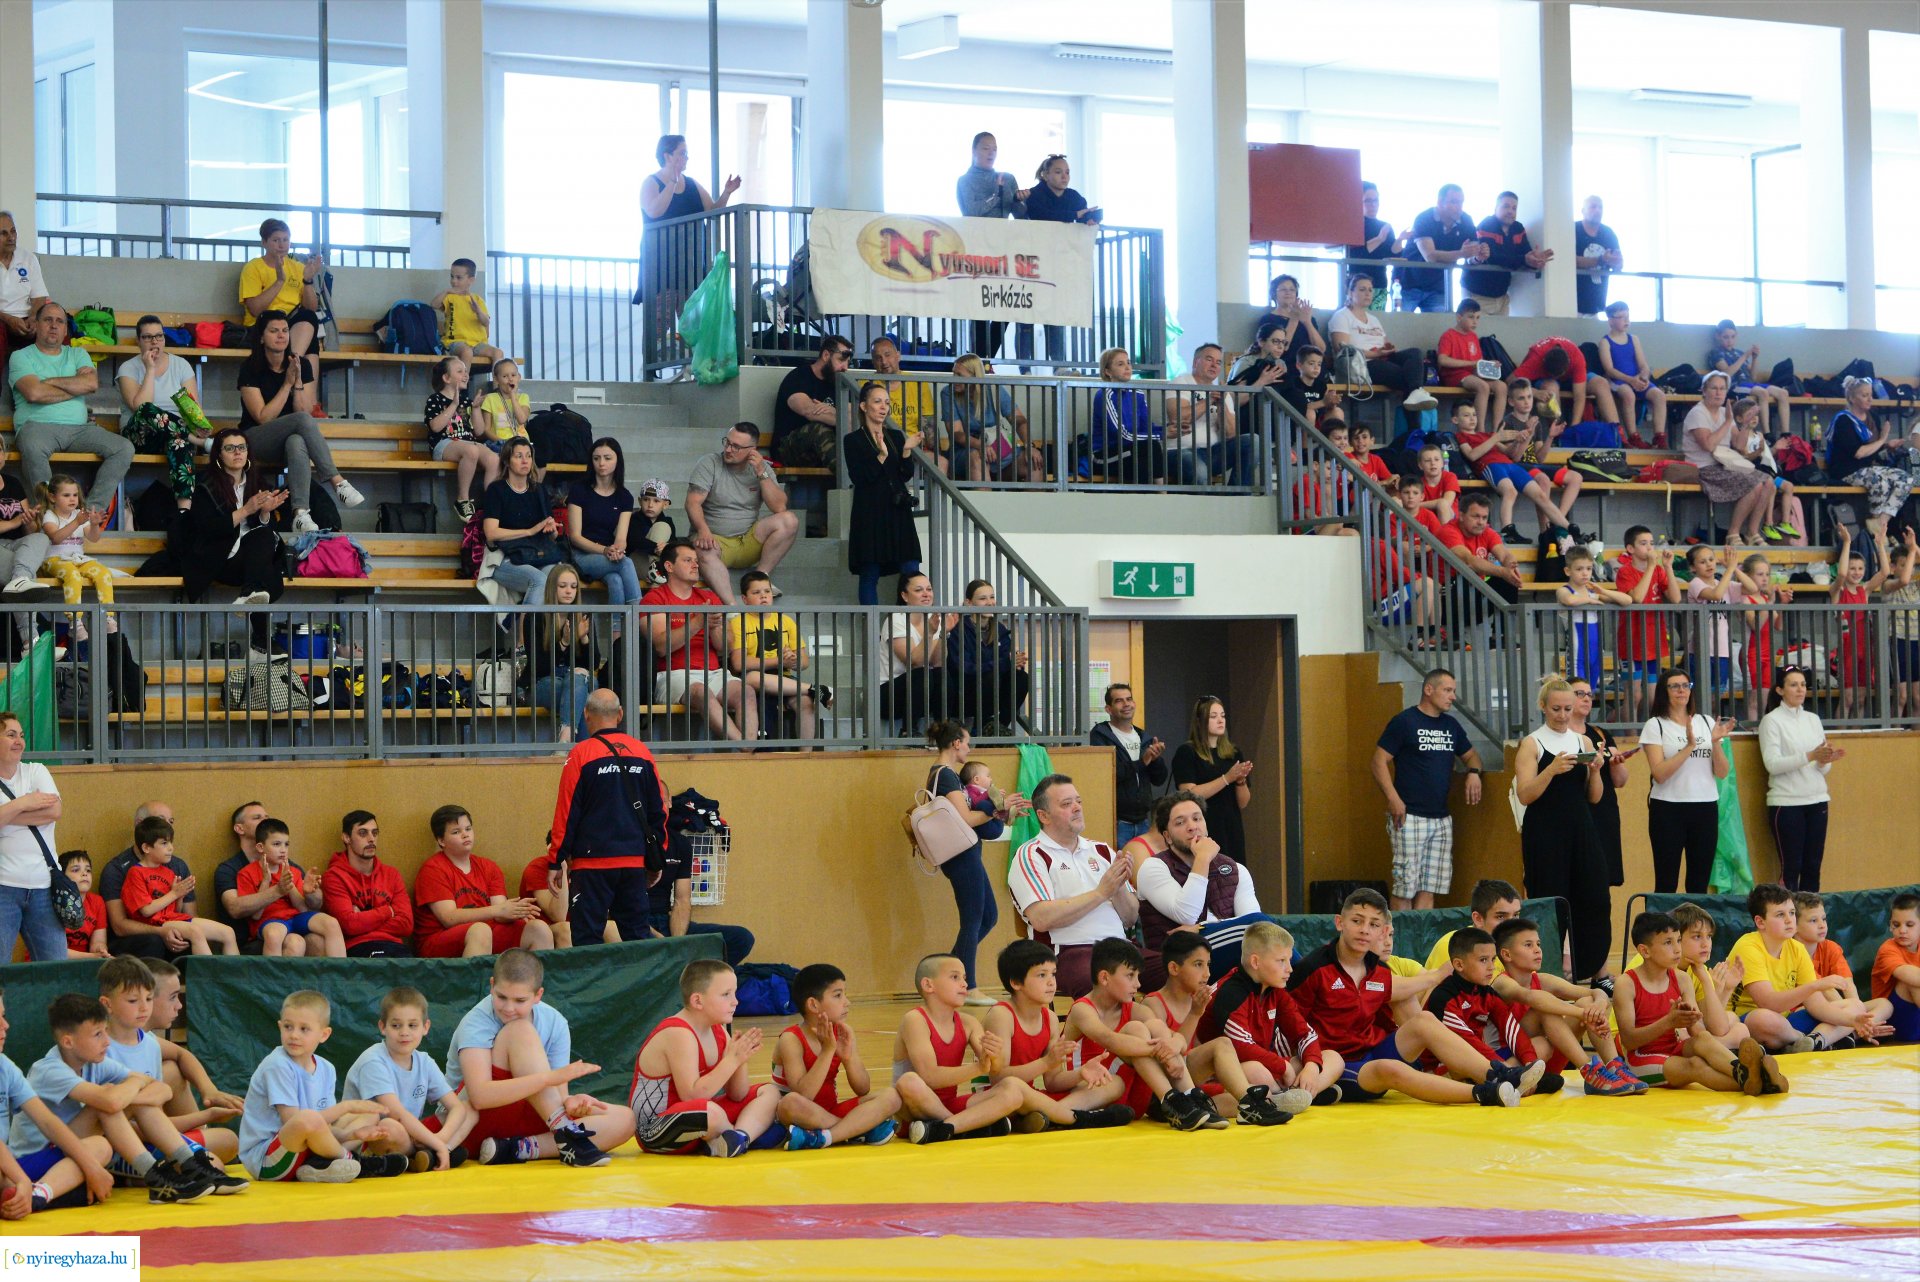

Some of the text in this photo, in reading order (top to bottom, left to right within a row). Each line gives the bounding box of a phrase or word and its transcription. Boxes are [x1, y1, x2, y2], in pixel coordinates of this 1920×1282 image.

[1014, 253, 1041, 279] SE
[981, 284, 1033, 309] Birkózás
[1174, 576, 1183, 584] 10
[1417, 729, 1453, 737] O'NEILL
[1418, 736, 1454, 744] O'NEILL
